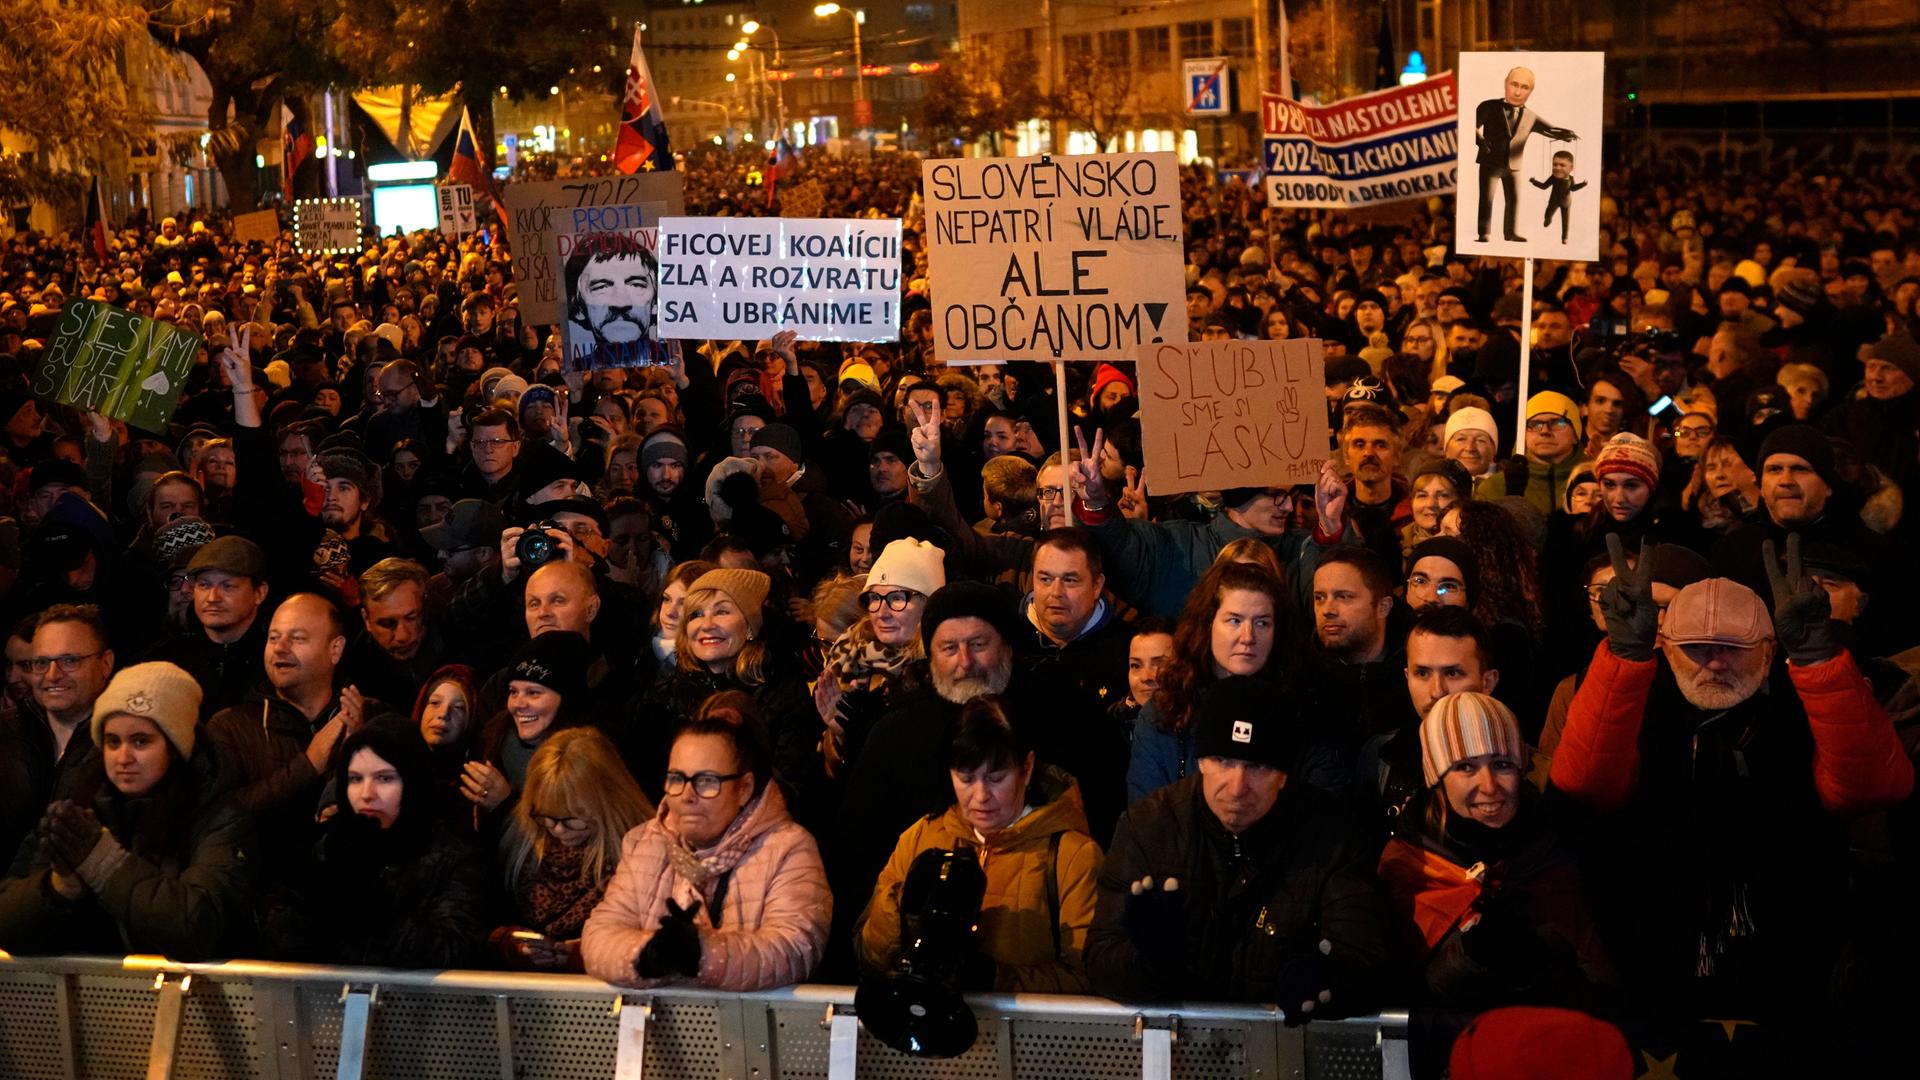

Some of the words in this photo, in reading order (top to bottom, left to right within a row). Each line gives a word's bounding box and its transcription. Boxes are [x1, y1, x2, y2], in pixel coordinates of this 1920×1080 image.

[1327, 86, 1456, 138] NASTOLENIE
[1271, 143, 1323, 172] 2024
[1339, 128, 1458, 176] ZACHOVANI
[456, 187, 471, 205] TU
[932, 159, 1156, 201] SLOVENSKO
[1275, 182, 1345, 203] SLOBODY
[572, 205, 643, 233] PROTI
[935, 202, 1054, 244] NEPATRÍ
[1077, 200, 1178, 242] VLÁDE,
[666, 233, 772, 256] FICOVEJ
[660, 263, 708, 286] ZLA
[718, 265, 738, 287] A
[751, 266, 898, 290] ROZVRATU
[1000, 250, 1109, 297] ALE
[664, 300, 698, 323] SA
[722, 297, 873, 325] UBRÁNIME
[945, 296, 1169, 351] OBČANOM!
[34, 364, 56, 395] S
[1153, 342, 1312, 400] SĽÚBILI
[1181, 401, 1224, 426] SME
[1234, 397, 1251, 417] SI
[1174, 415, 1309, 480] LÁSKU
